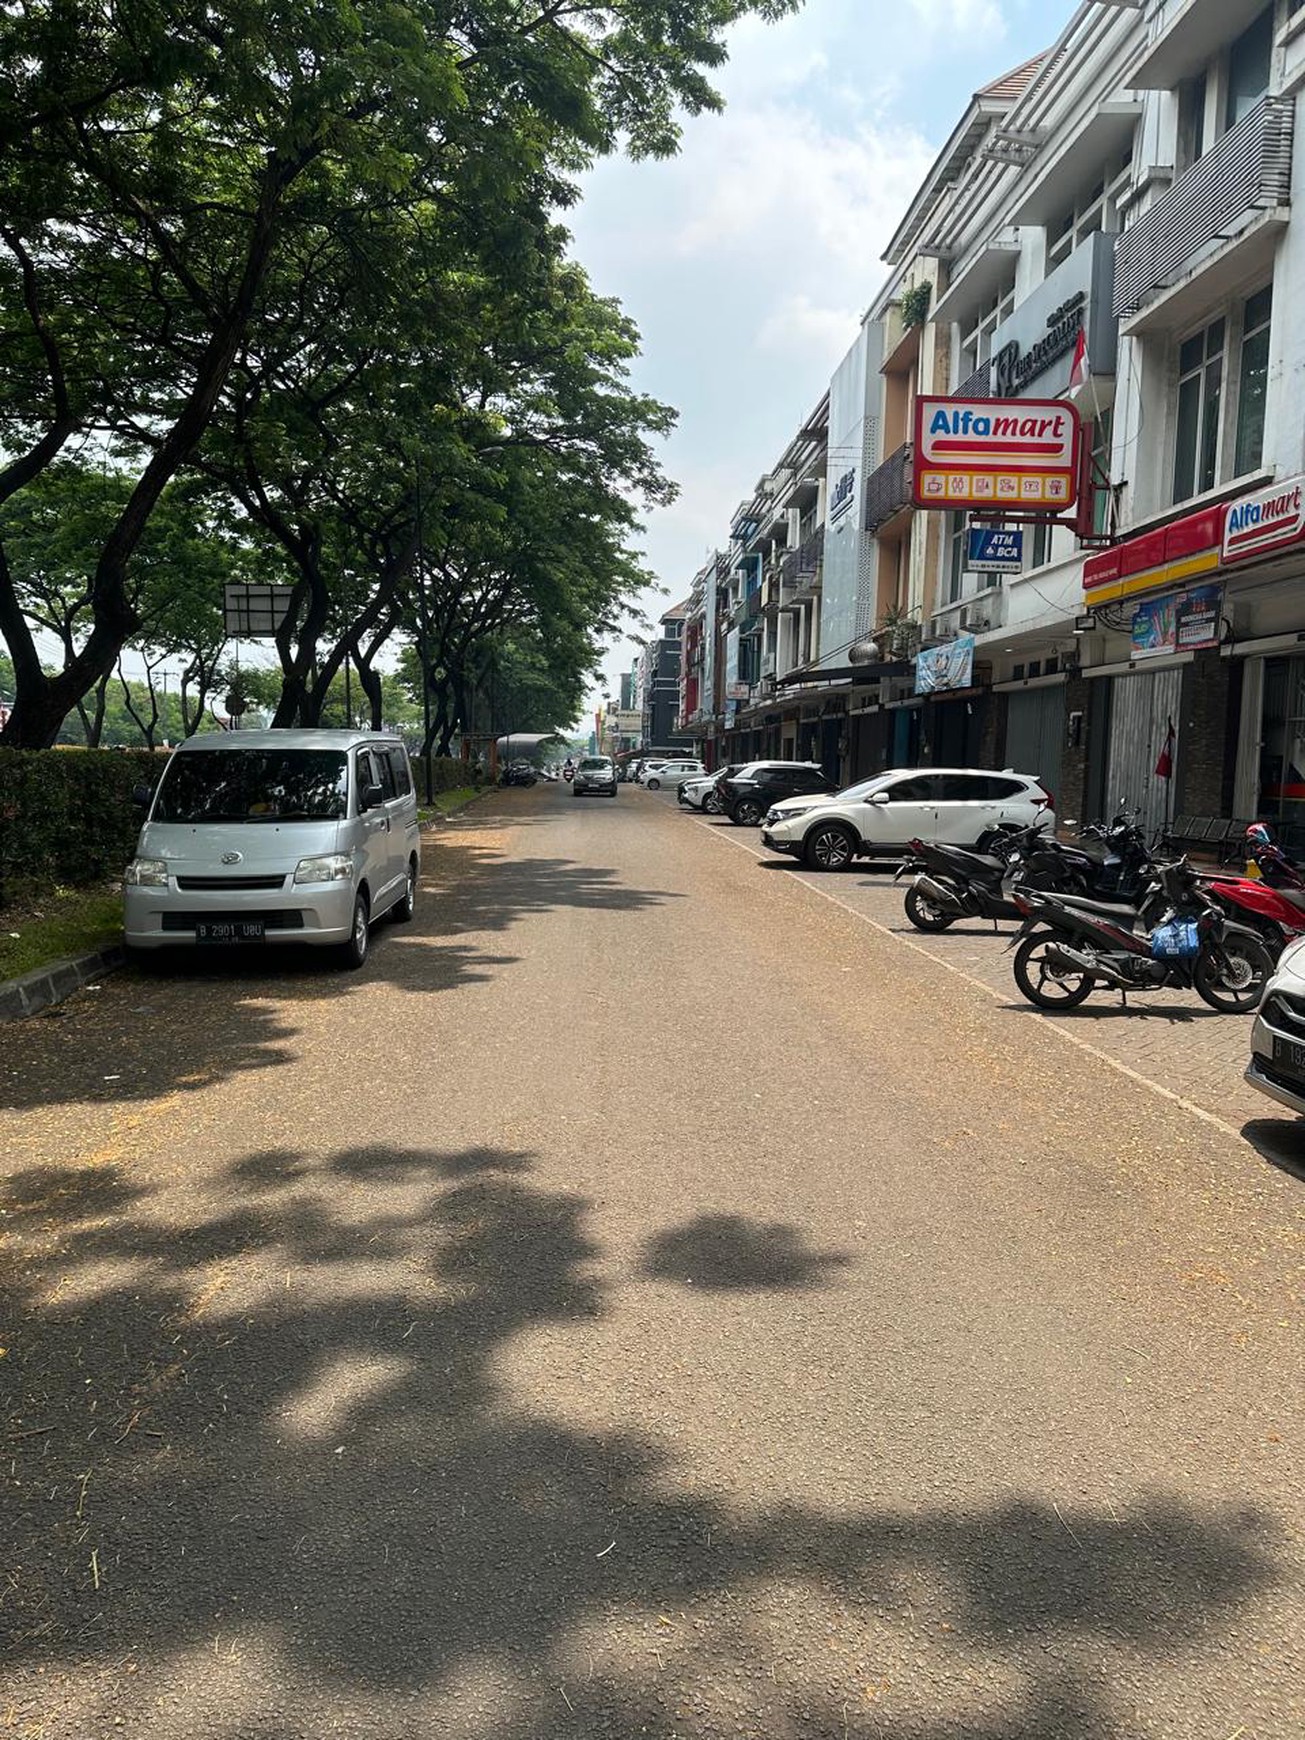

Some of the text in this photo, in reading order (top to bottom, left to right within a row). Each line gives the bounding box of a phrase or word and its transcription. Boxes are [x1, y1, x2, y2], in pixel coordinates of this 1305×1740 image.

[930, 410, 1065, 438] Alfamart
[1229, 486, 1302, 534] Alfamart
[991, 534, 1014, 545] ATM
[996, 547, 1018, 557] BCA
[200, 925, 206, 937] B
[211, 924, 235, 937] 2901
